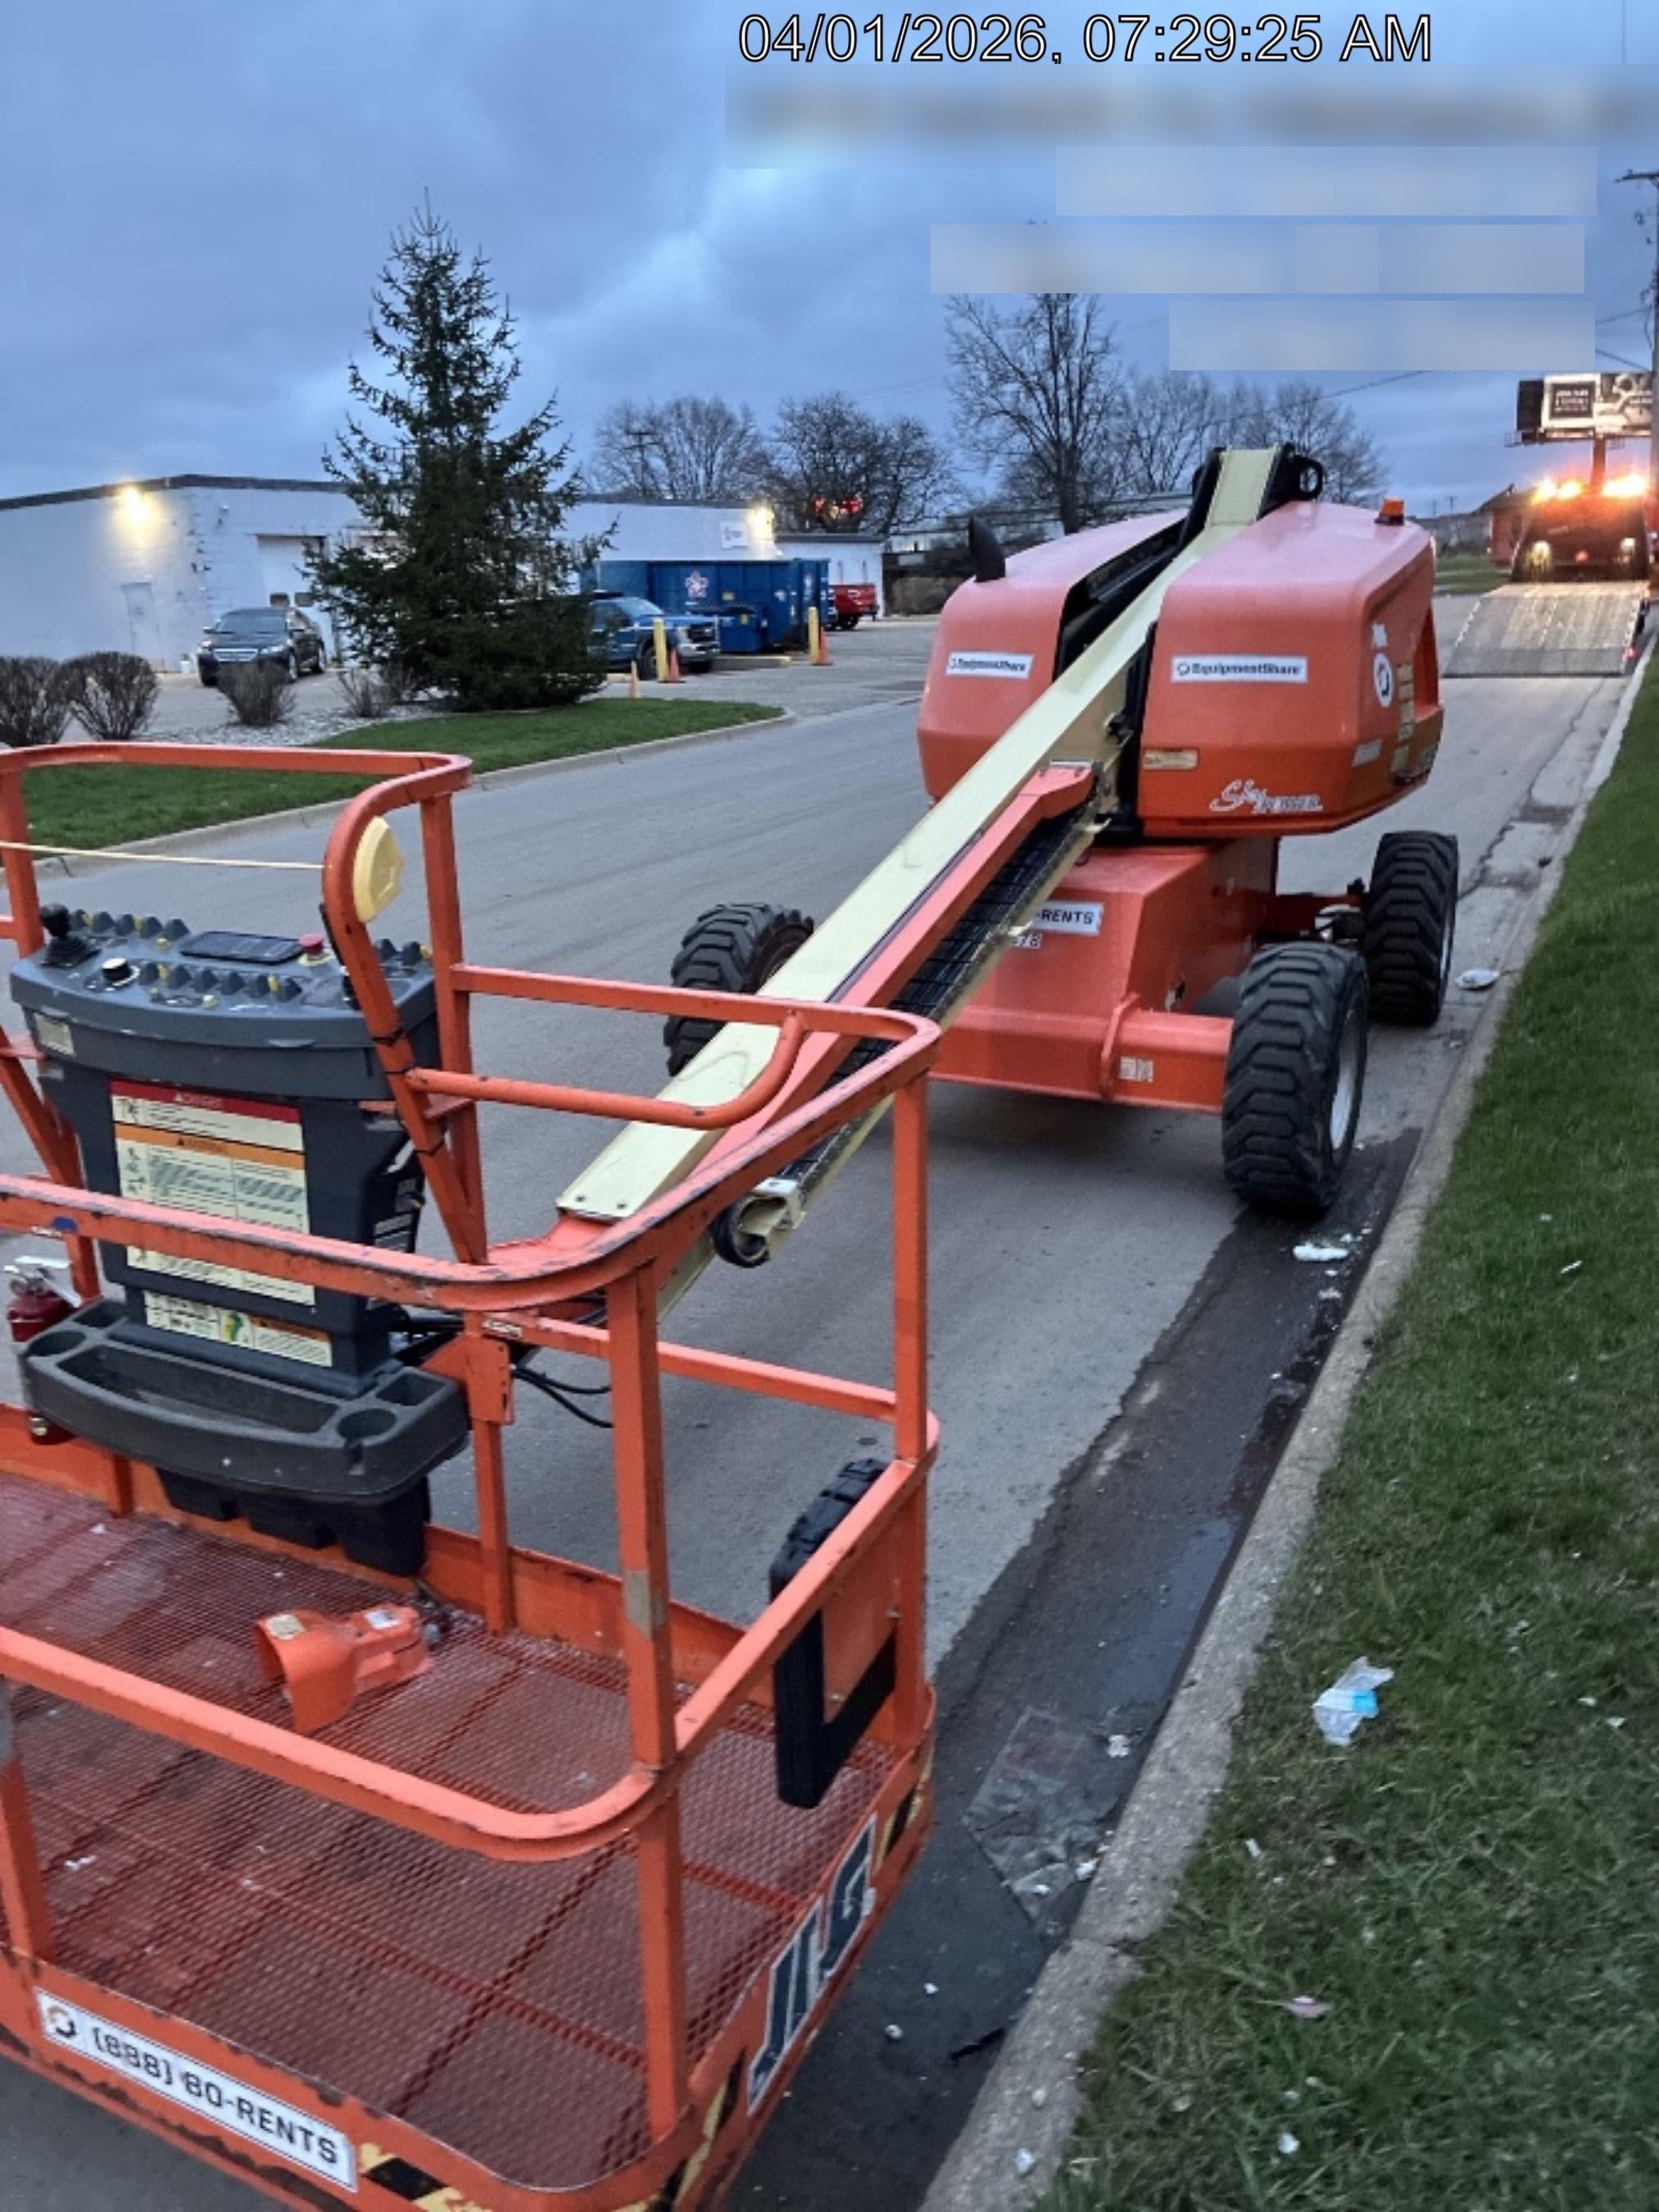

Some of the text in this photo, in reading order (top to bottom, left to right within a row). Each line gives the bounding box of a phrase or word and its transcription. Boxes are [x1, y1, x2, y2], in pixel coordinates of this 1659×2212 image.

[1190, 662, 1301, 677] EquipmentShare
[1036, 909, 1095, 925] -RENTS
[92, 2026, 338, 2165] (888) 80-RENTS
